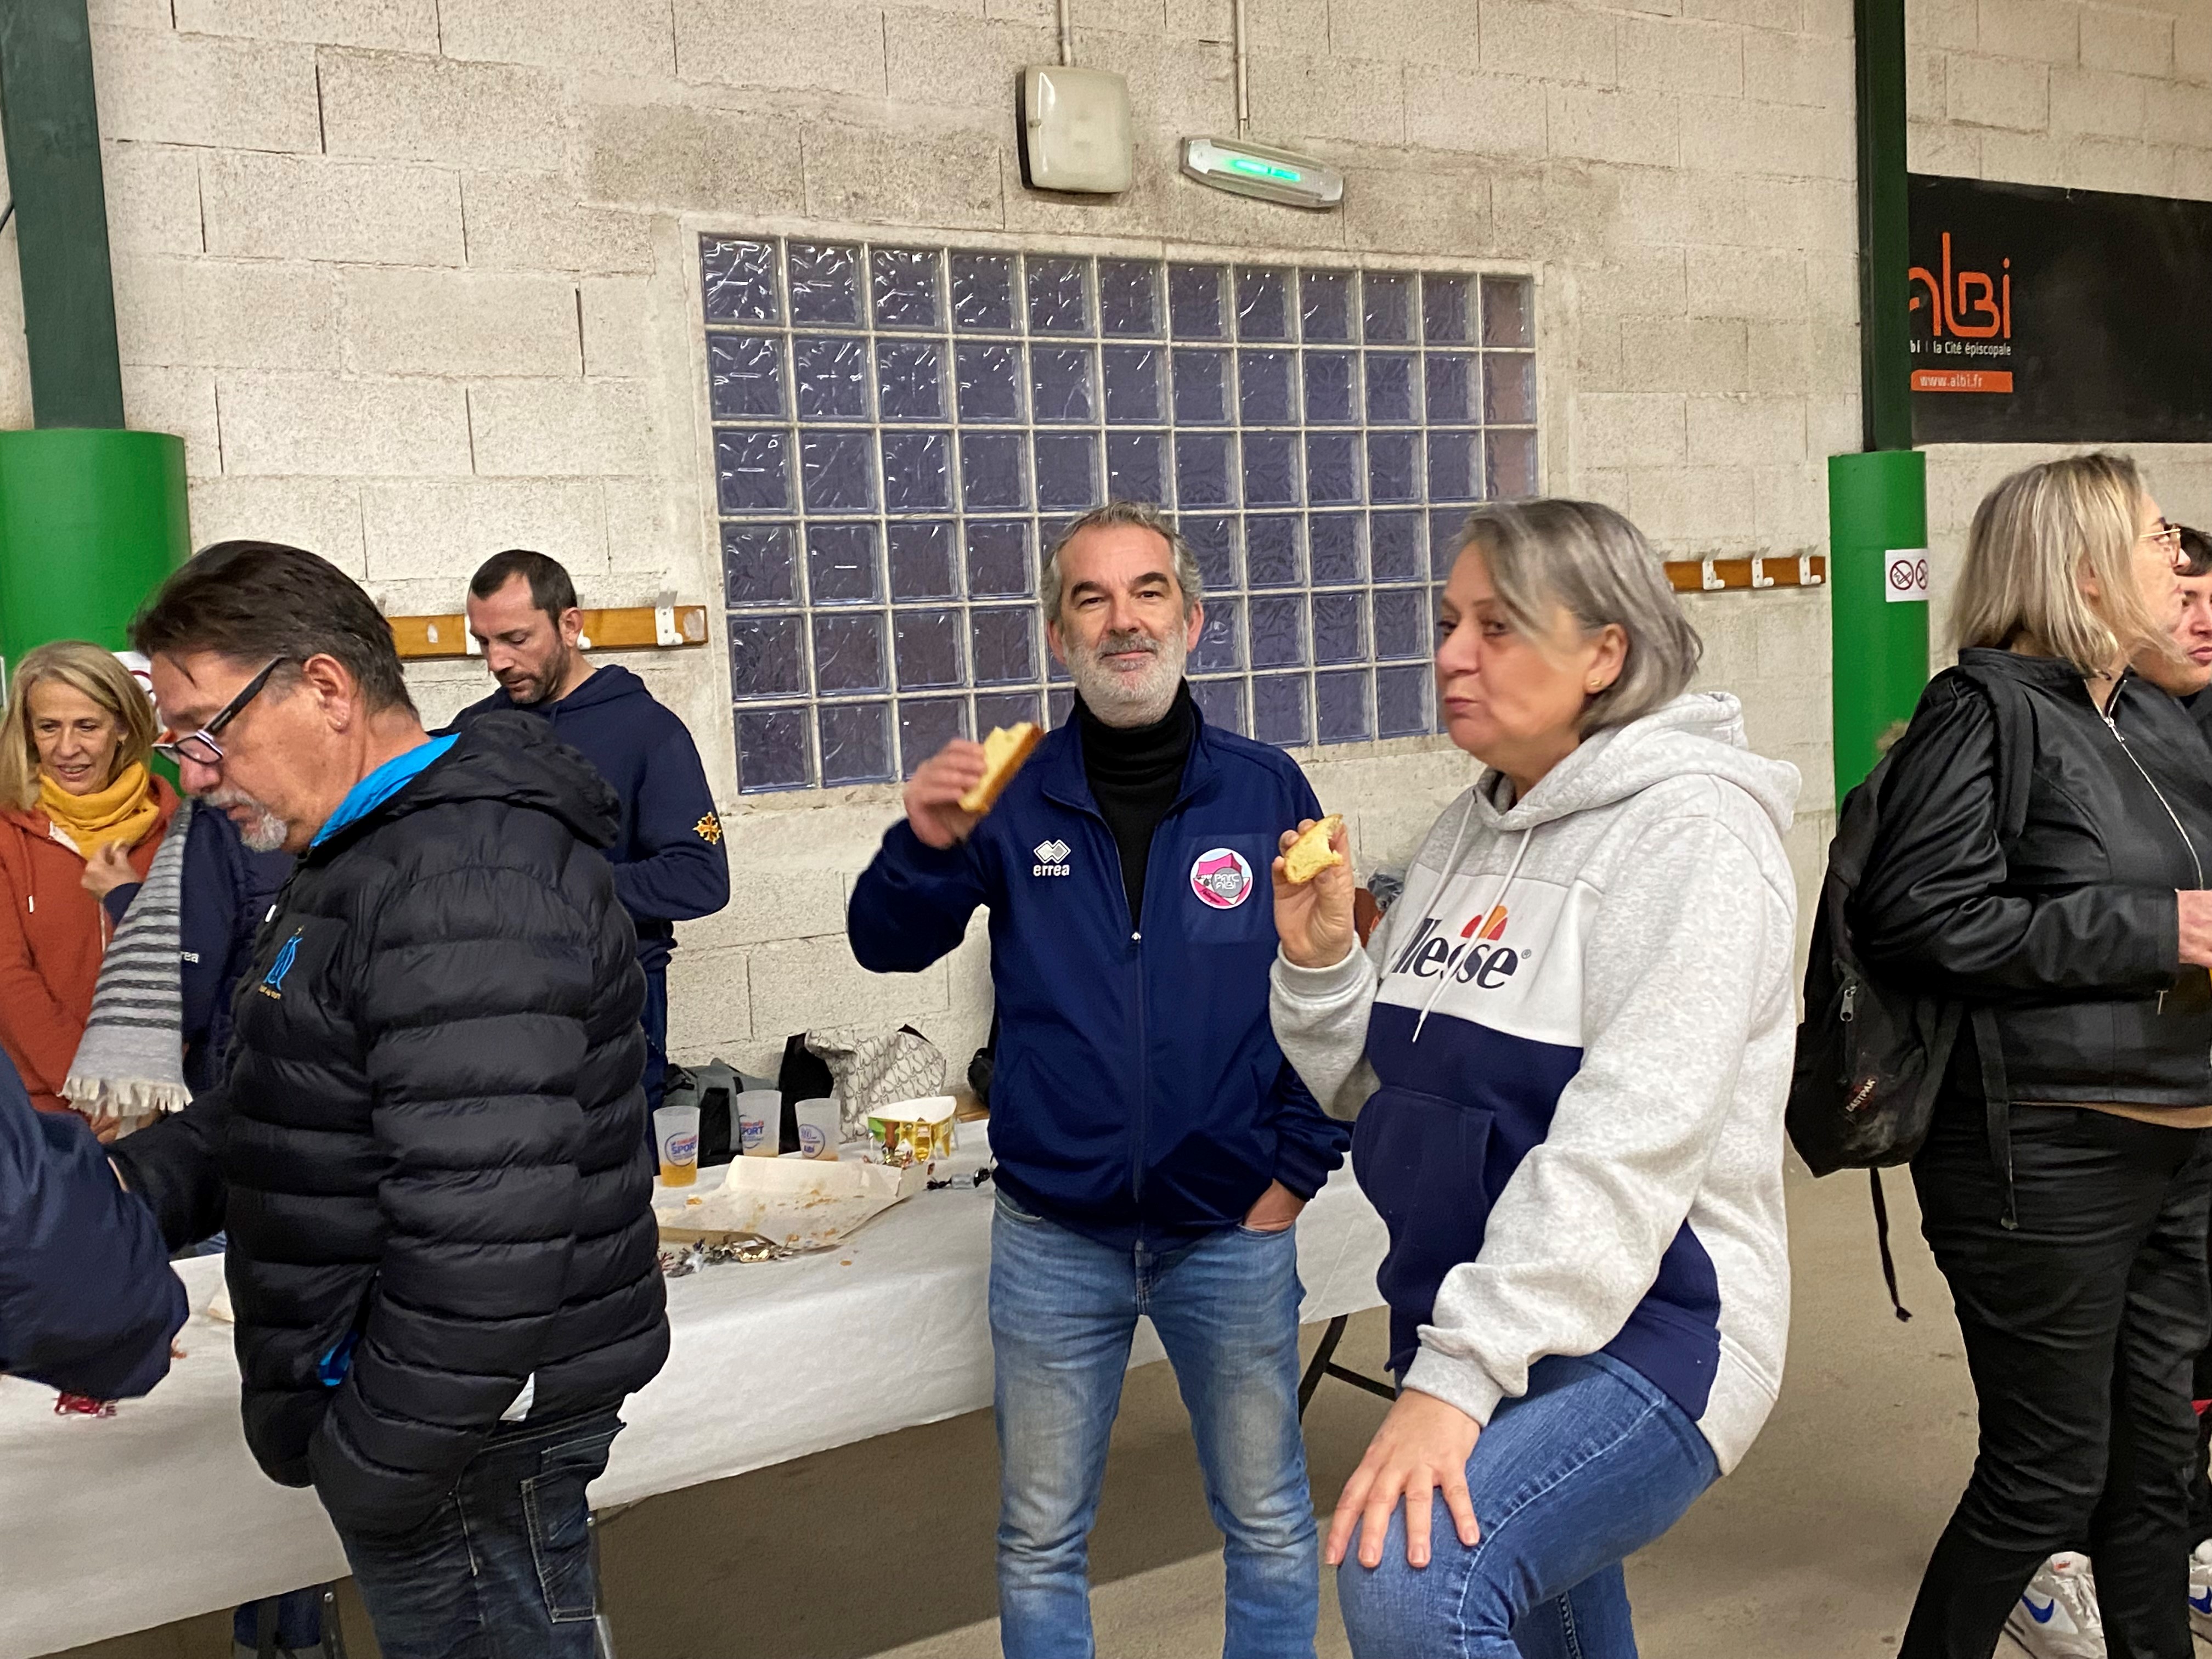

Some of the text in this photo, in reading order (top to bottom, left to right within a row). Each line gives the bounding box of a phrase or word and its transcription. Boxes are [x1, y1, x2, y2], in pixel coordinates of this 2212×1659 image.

[1933, 340, 1943, 354] la
[1945, 341, 1962, 355] Cité
[1965, 342, 2012, 358] épiscopale
[1920, 374, 1983, 388] www.albi.fr
[1033, 864, 1070, 877] errea
